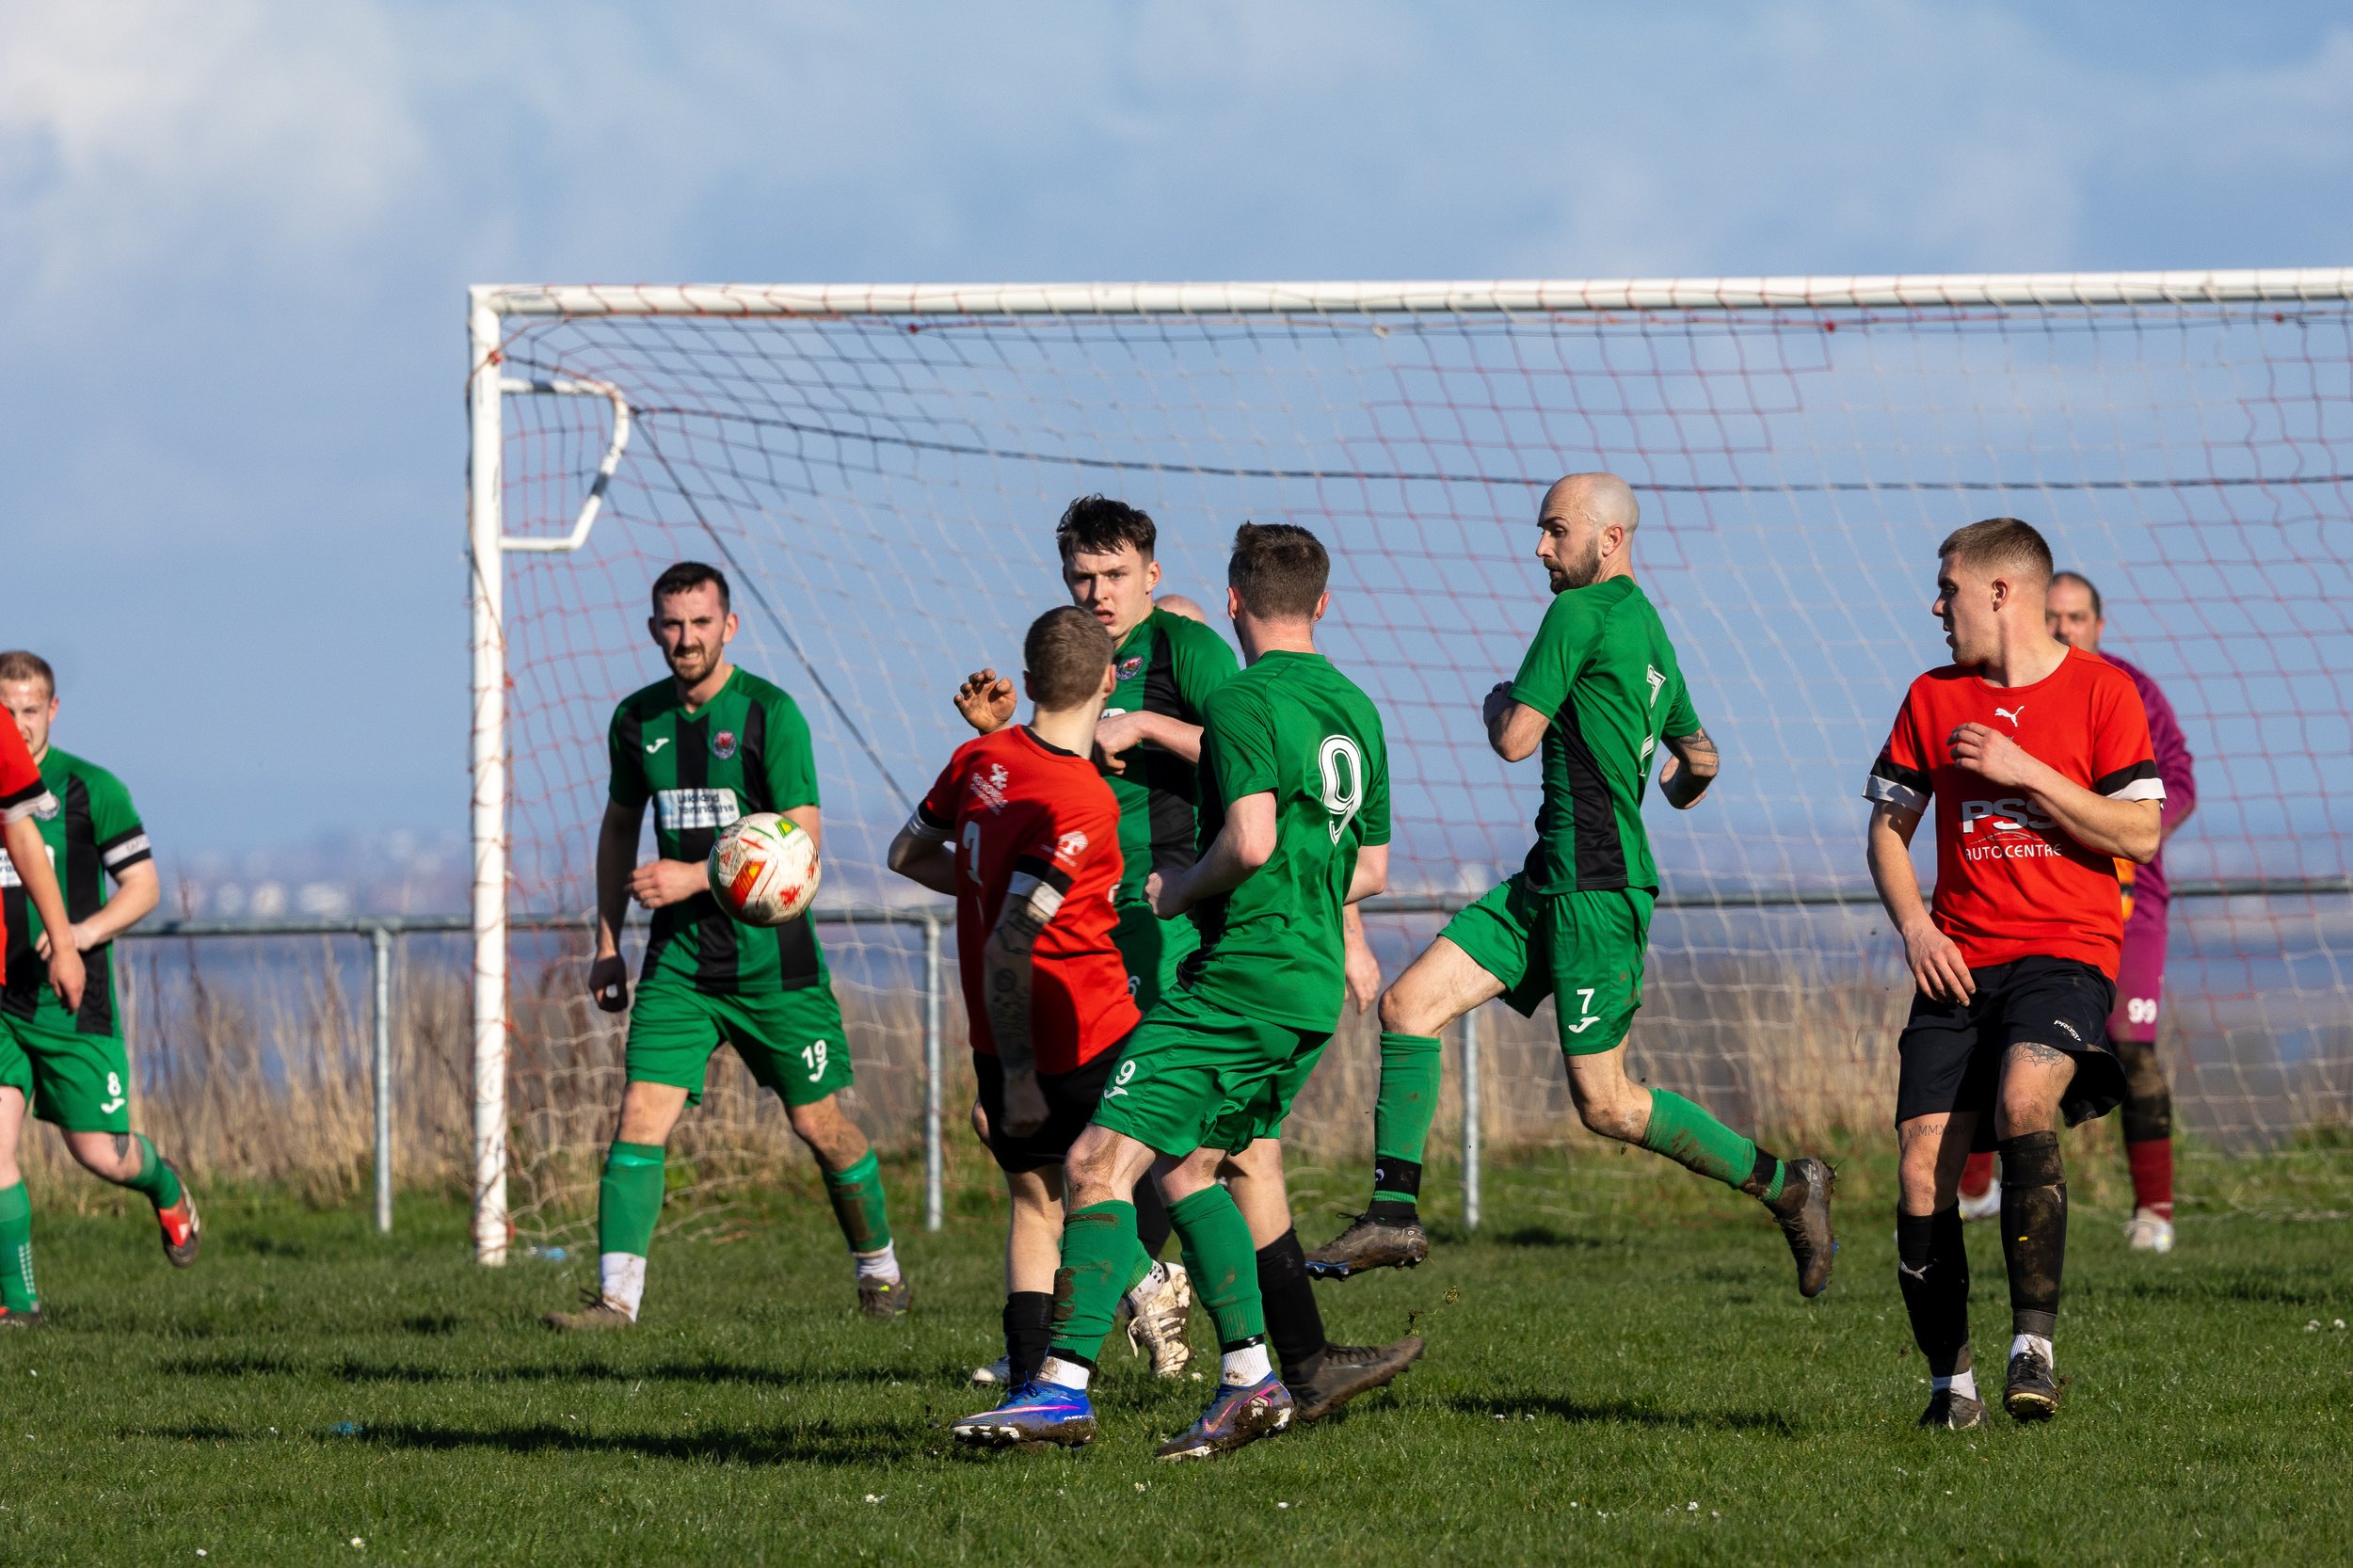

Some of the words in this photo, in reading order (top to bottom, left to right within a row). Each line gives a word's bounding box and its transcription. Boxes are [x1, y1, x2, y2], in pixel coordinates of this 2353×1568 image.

[1318, 734, 1363, 846] 9
[1961, 797, 2059, 834] PSS
[1964, 845, 2004, 861] AUTO
[2005, 843, 2062, 858] CENTRE
[1128, 975, 1141, 997] 6
[1576, 987, 1595, 1015] 7
[2127, 997, 2158, 1025] 99
[801, 1038, 827, 1069] 19
[106, 1070, 122, 1097] 8
[1114, 1059, 1136, 1085] 9
